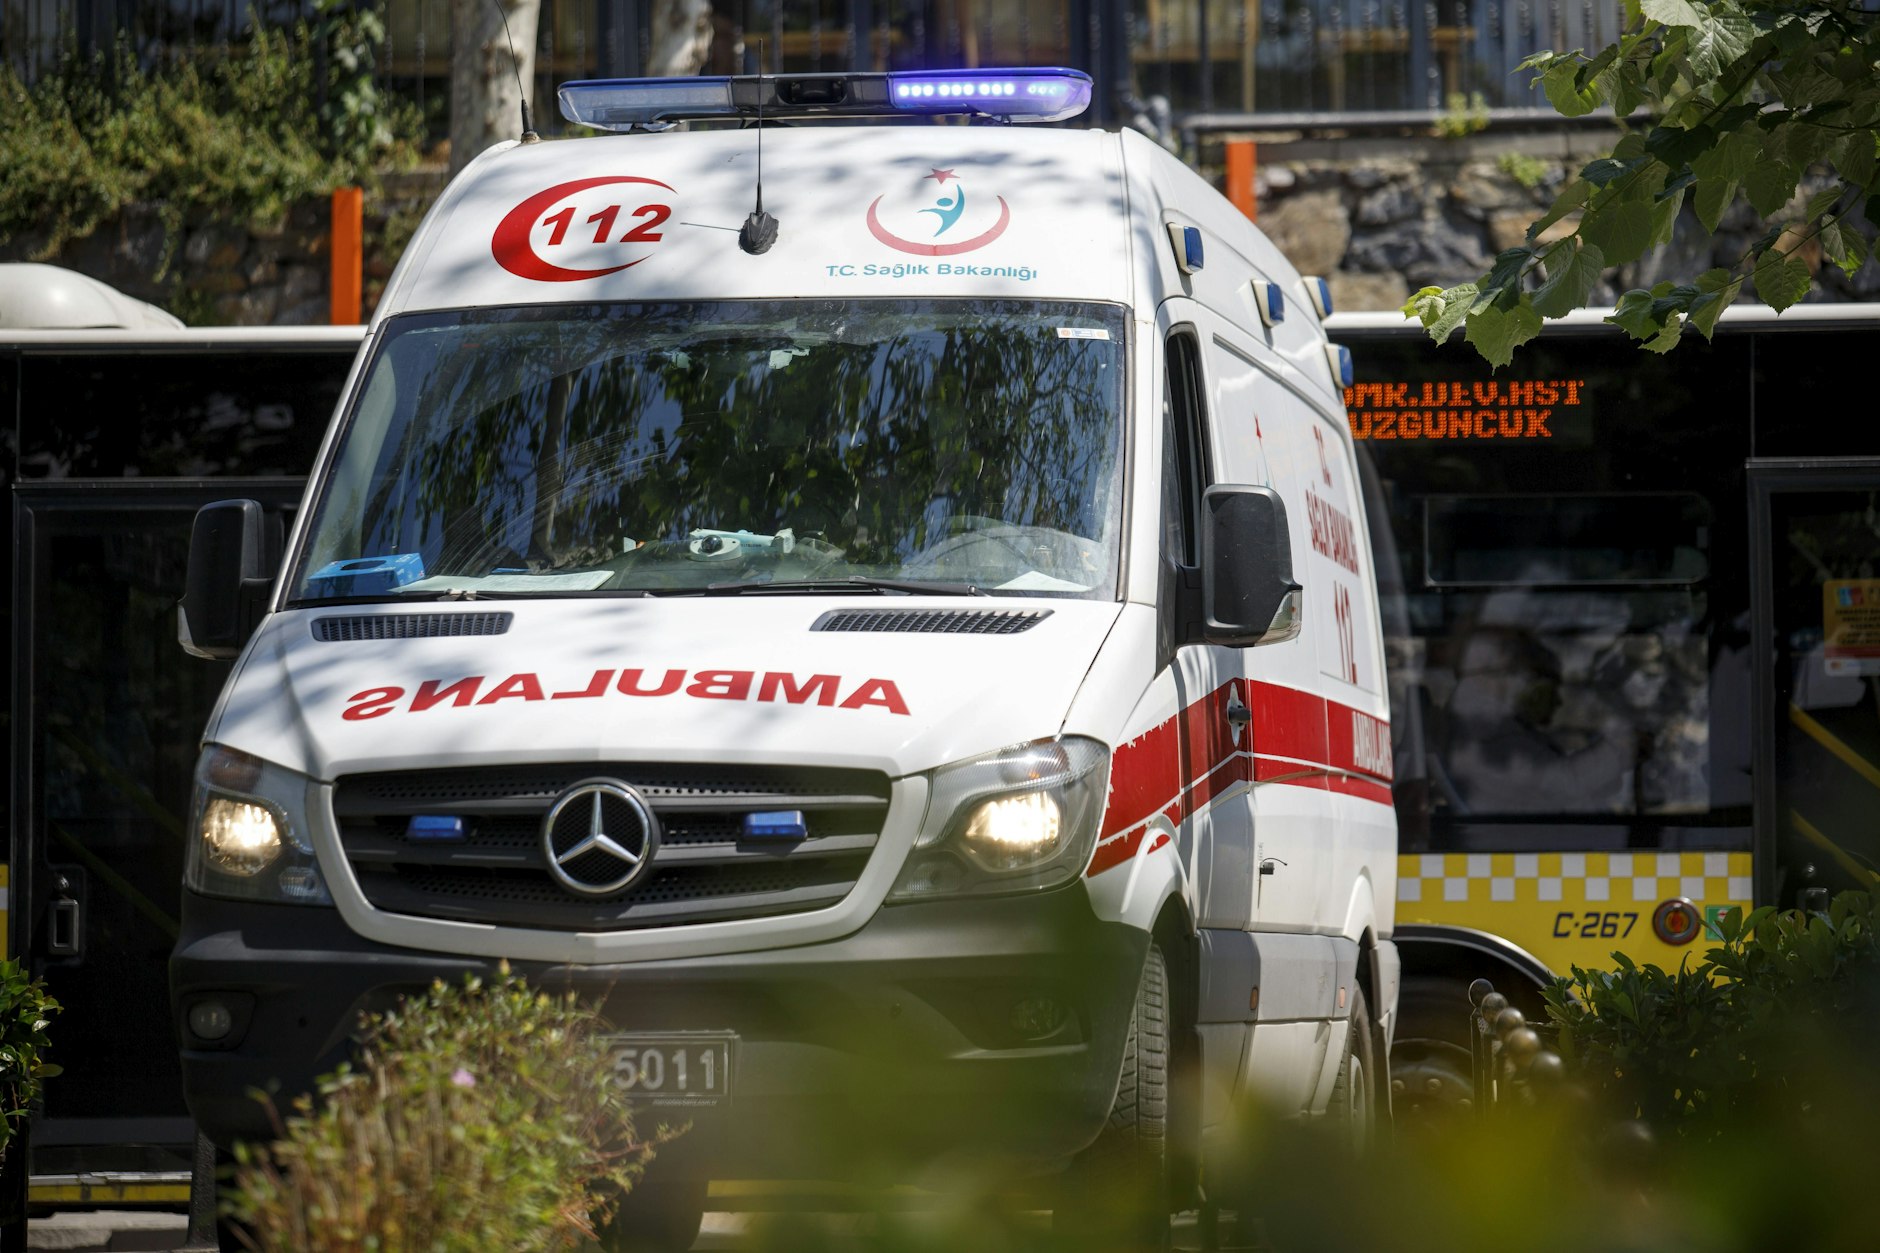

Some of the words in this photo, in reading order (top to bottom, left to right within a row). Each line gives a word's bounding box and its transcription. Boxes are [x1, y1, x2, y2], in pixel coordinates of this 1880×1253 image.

[541, 204, 673, 246] 112
[825, 265, 857, 277] T.C.
[863, 263, 929, 279] Sağlık
[937, 263, 1038, 281] Bakanlığı
[1333, 580, 1358, 685] 112
[613, 1048, 715, 1090] 5011
